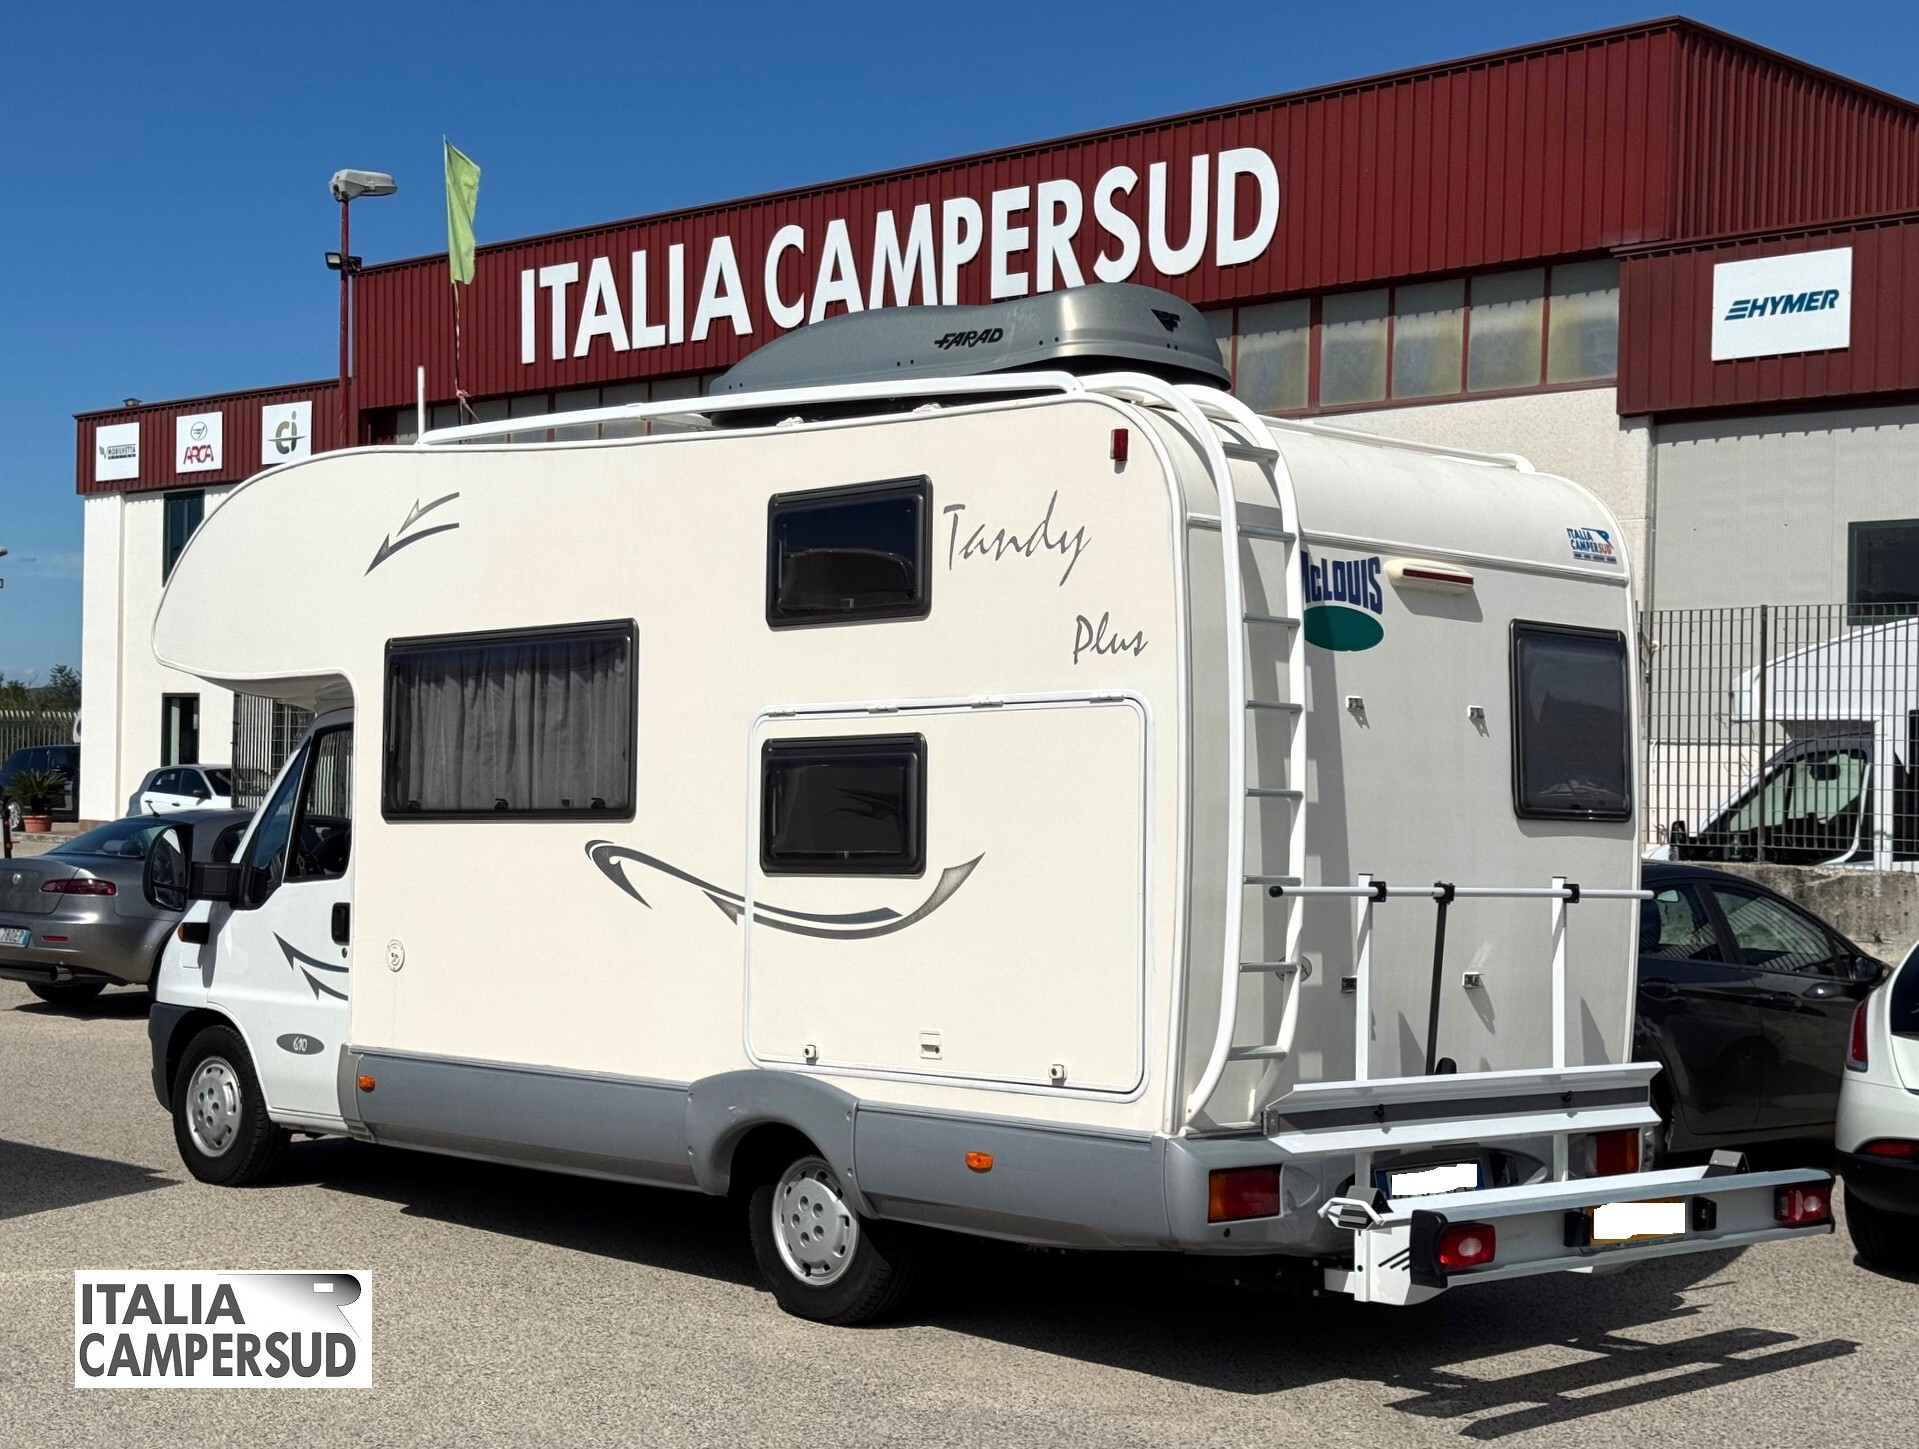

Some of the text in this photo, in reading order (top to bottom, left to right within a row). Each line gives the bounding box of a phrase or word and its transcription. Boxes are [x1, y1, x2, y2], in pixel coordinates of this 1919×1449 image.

[521, 147, 1280, 364] ITALIA CAMPERSUD
[1734, 289, 1840, 320] HYMER
[934, 327, 1004, 350] FARAD
[183, 444, 214, 465] ARCA
[943, 489, 1092, 587] Tandy
[1566, 527, 1593, 541] ITALIA
[1570, 539, 1613, 555] CAMPERSUD
[1073, 611, 1148, 665] Plus
[292, 1036, 308, 1052] 610
